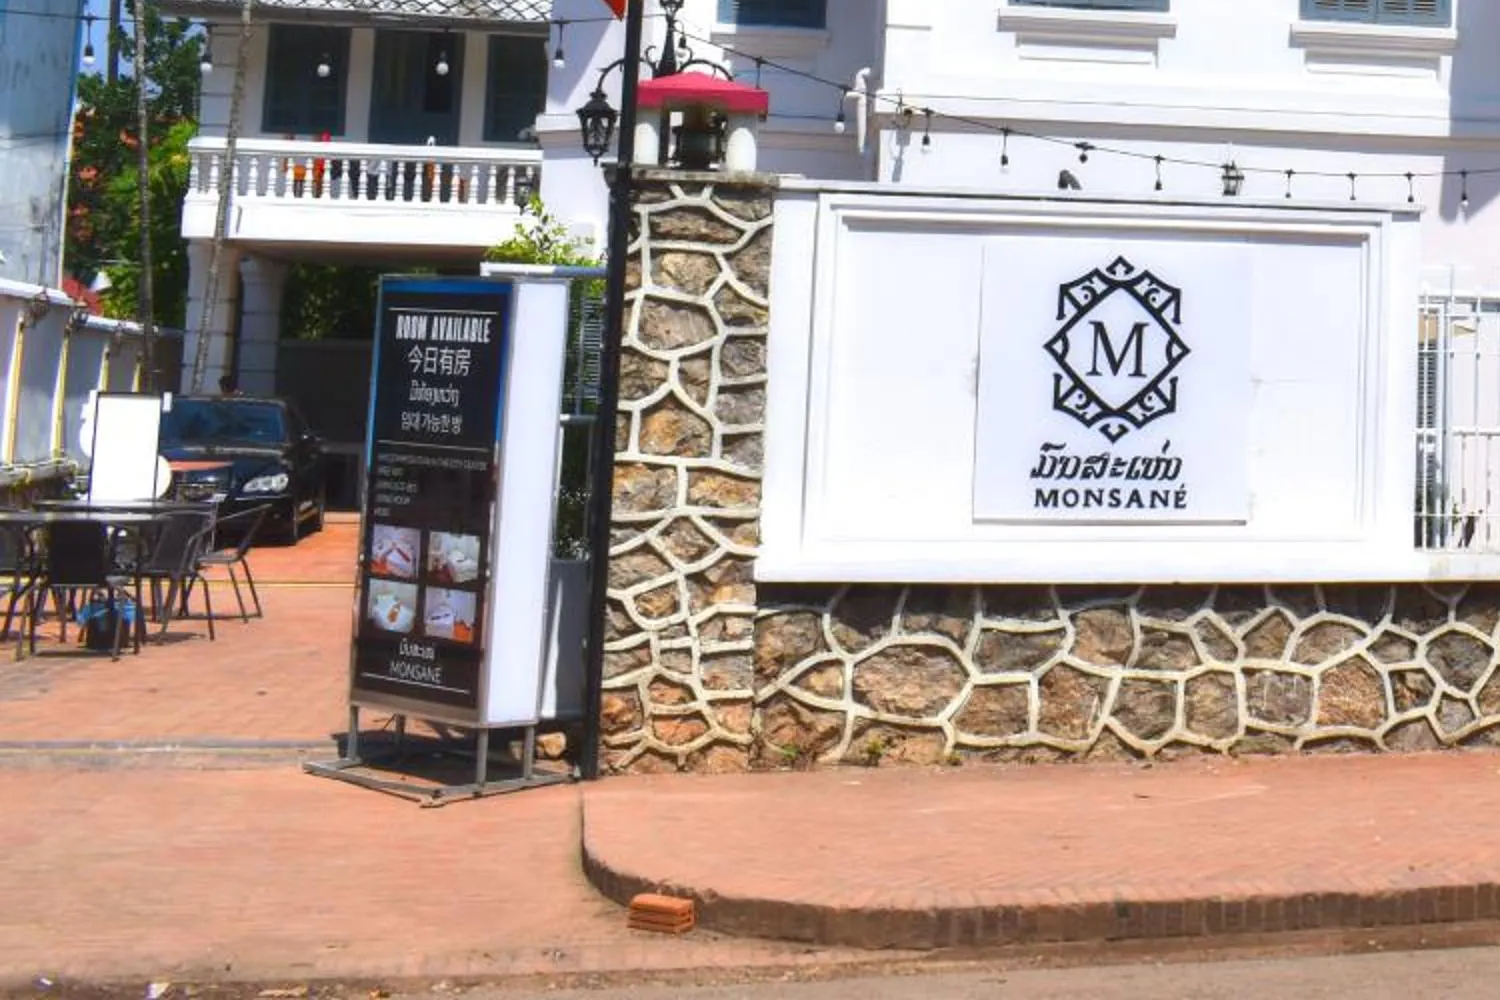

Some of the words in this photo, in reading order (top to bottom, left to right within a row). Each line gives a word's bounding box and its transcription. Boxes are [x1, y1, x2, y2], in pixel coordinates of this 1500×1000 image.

[396, 315, 428, 340] ROOM
[431, 315, 492, 343] AVAILABLE
[408, 345, 471, 376] 今日有房
[1085, 320, 1150, 378] M
[1034, 483, 1187, 509] MONSANÉ
